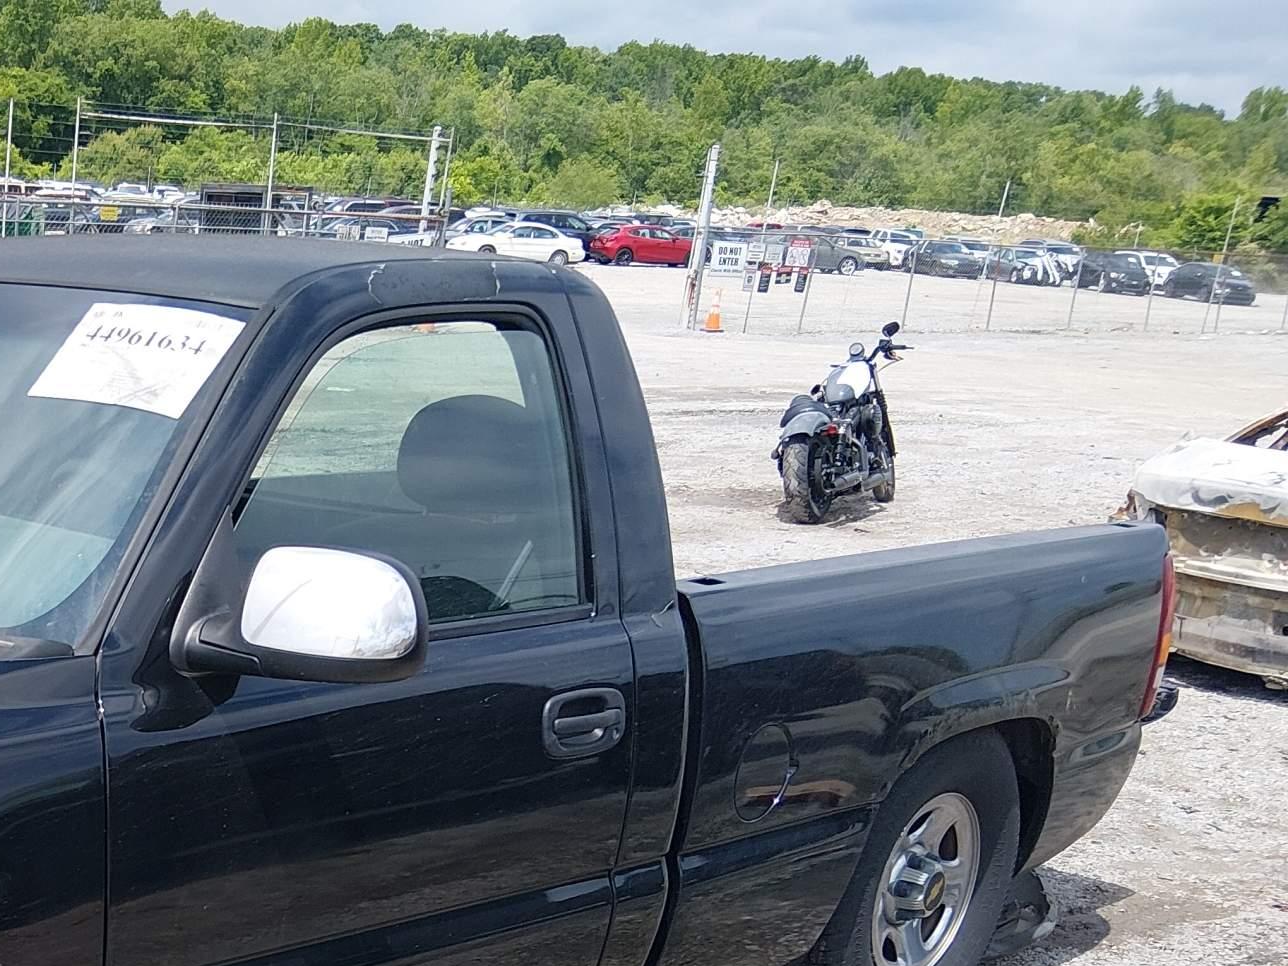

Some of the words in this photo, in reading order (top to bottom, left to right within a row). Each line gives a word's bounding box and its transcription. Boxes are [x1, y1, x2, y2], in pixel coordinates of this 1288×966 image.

[718, 246, 728, 255] DO
[728, 247, 742, 256] NOT
[718, 257, 739, 266] ENTER
[86, 325, 207, 355] 44961634
